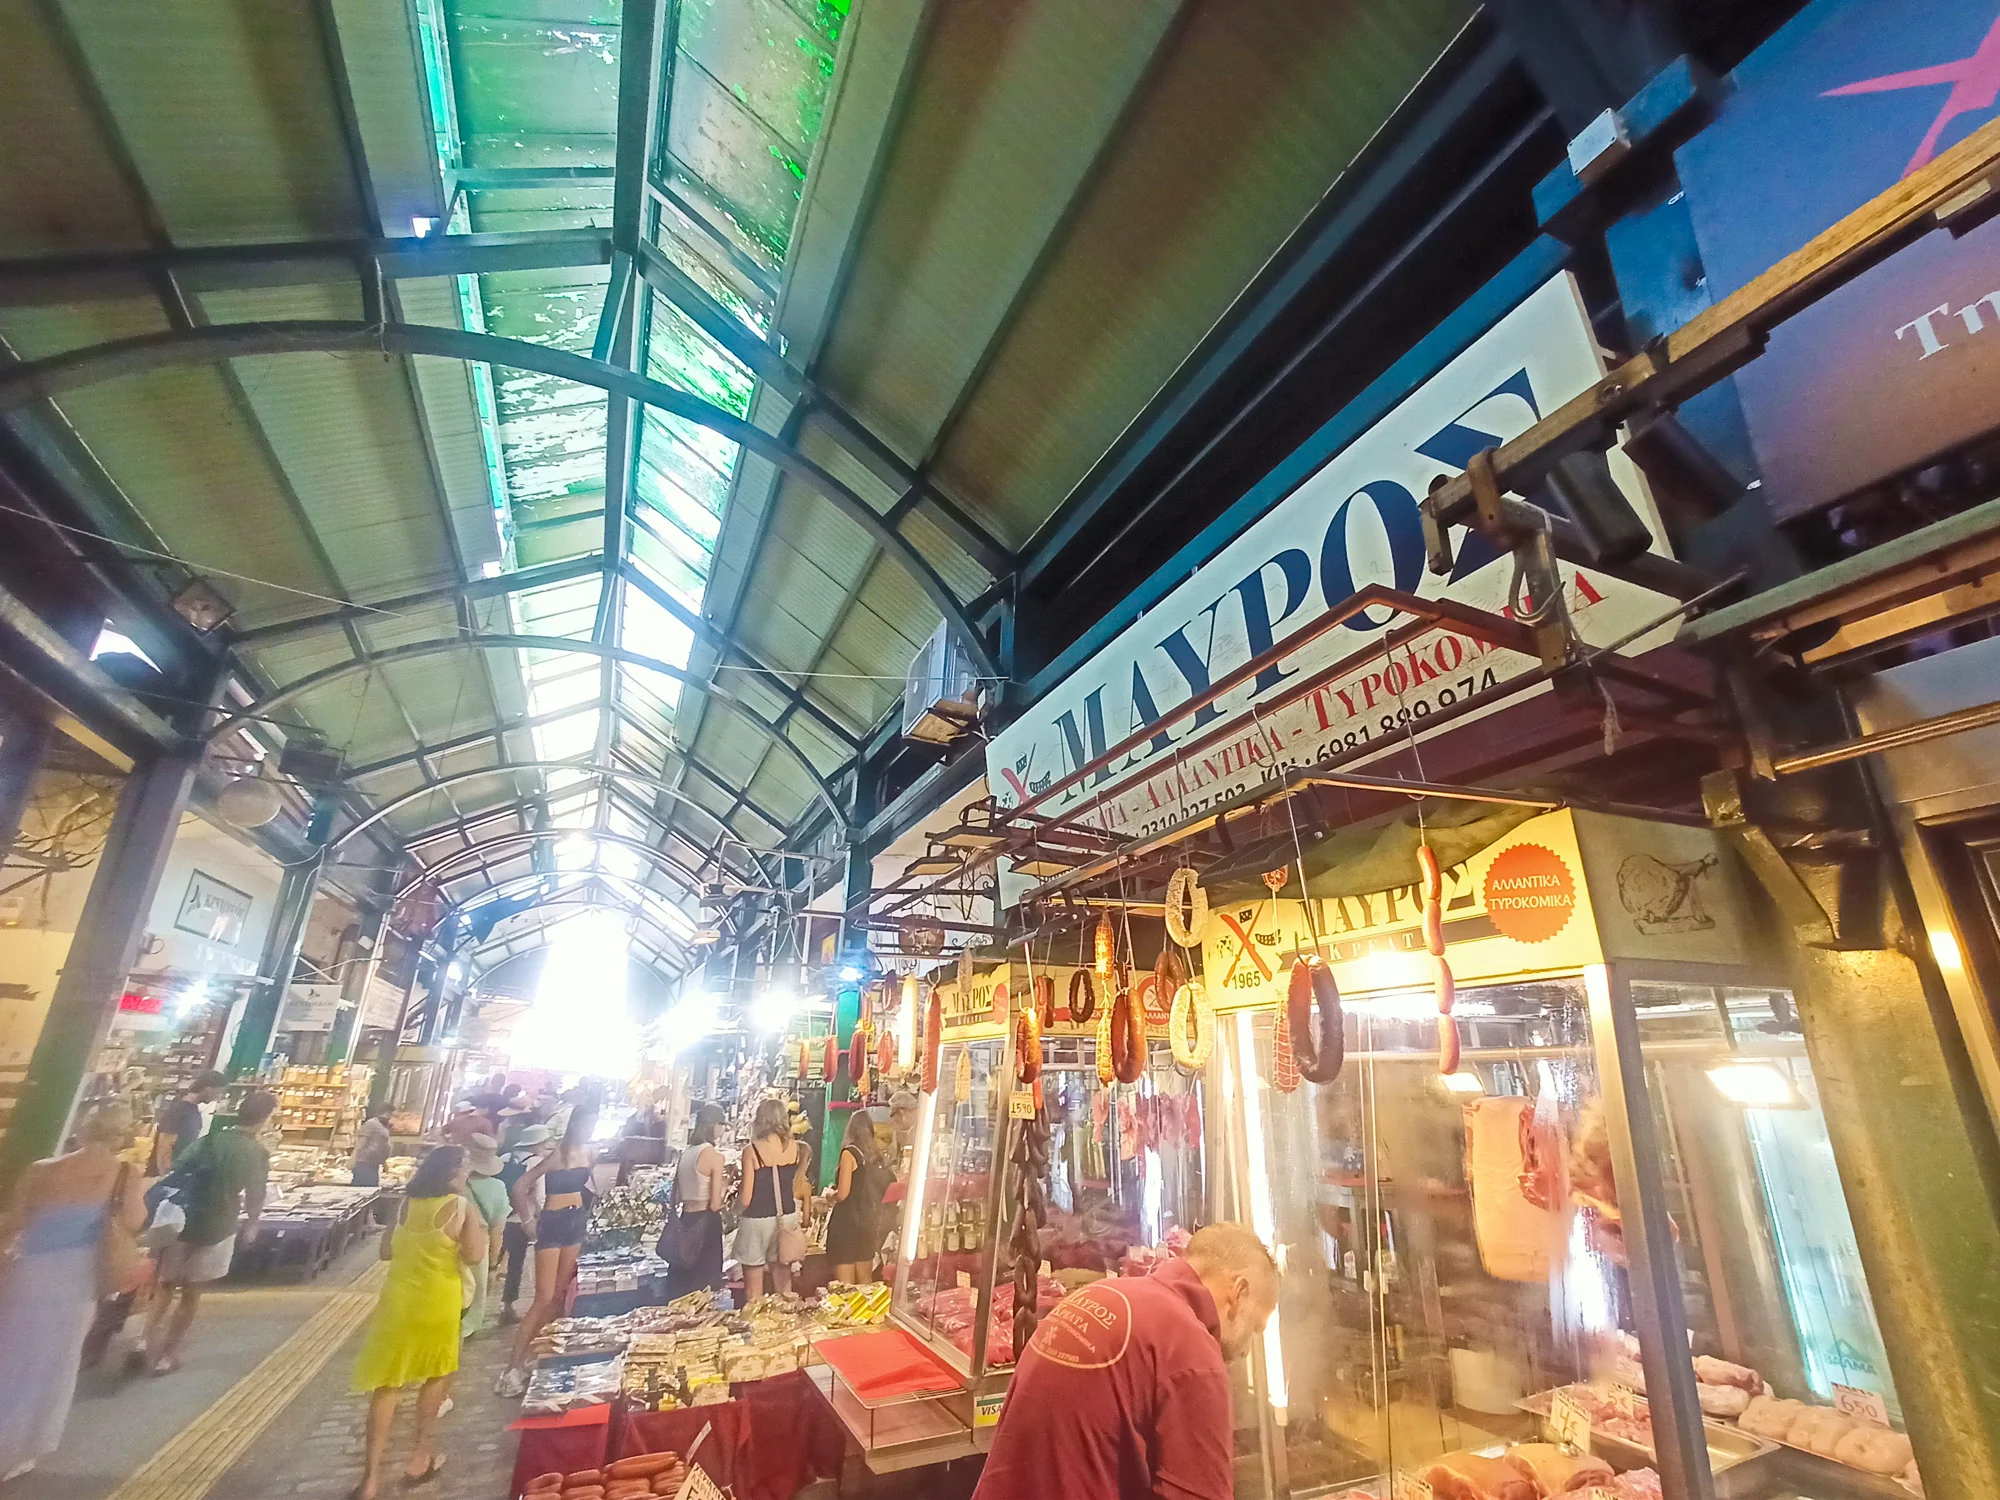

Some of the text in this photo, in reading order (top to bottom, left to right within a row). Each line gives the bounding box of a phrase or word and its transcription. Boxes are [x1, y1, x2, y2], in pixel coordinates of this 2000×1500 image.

[1051, 366, 1542, 806] ΜΑΥΡΟΣ
[1305, 570, 1609, 732] ΤΥΡΟΚΟΜΑ
[1492, 874, 1561, 891] ΑΛΛΑΝΤΙΚΑ
[1490, 894, 1573, 910] ΤΥΡΟΚΟΜΙΚΑ
[1328, 932, 1426, 961] ΚΡΕΑΤ
[1232, 971, 1261, 989] 1965
[1145, 1012, 1170, 1020] ΑΛΛΑΝΤ
